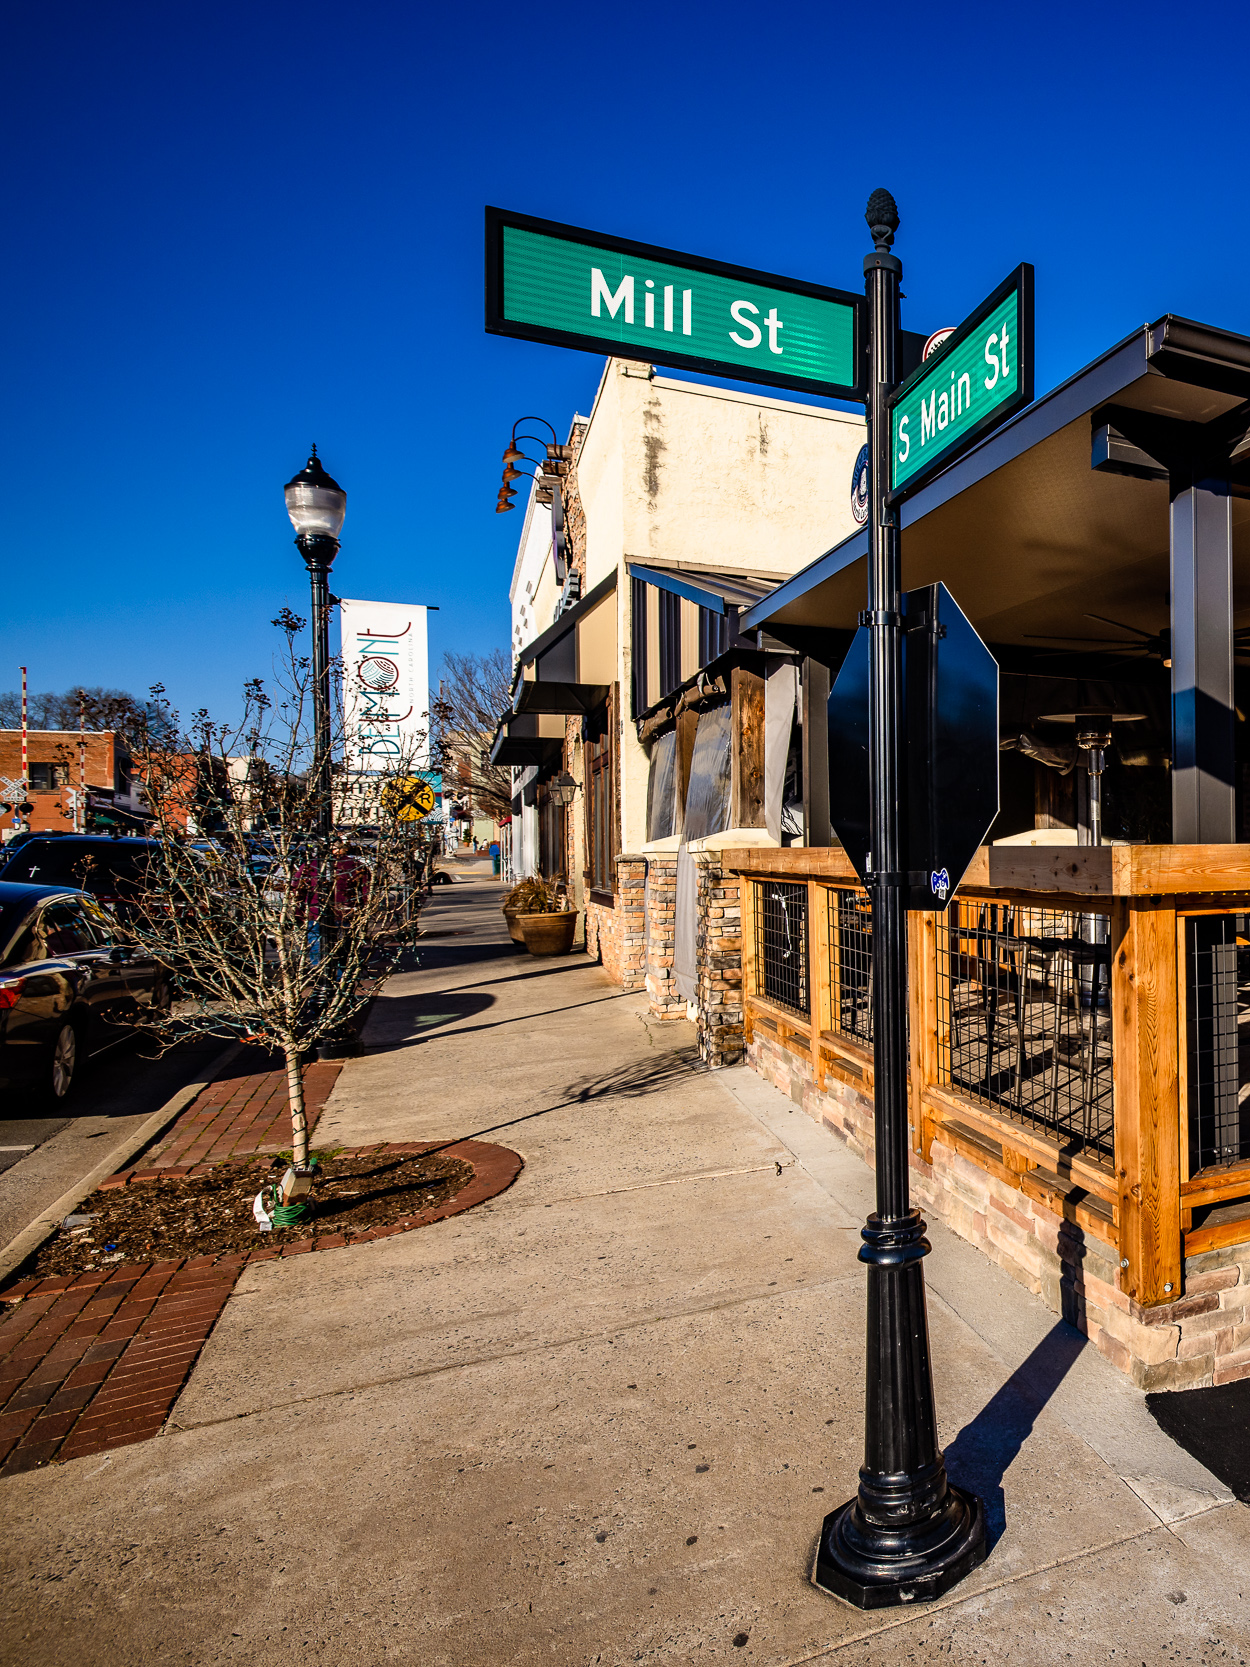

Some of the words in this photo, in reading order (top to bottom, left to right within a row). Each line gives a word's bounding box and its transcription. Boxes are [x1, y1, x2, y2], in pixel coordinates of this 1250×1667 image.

[591, 267, 692, 336] Mill
[728, 300, 784, 355] St
[898, 414, 911, 463] S
[920, 370, 971, 447] Main
[983, 321, 1010, 390] St
